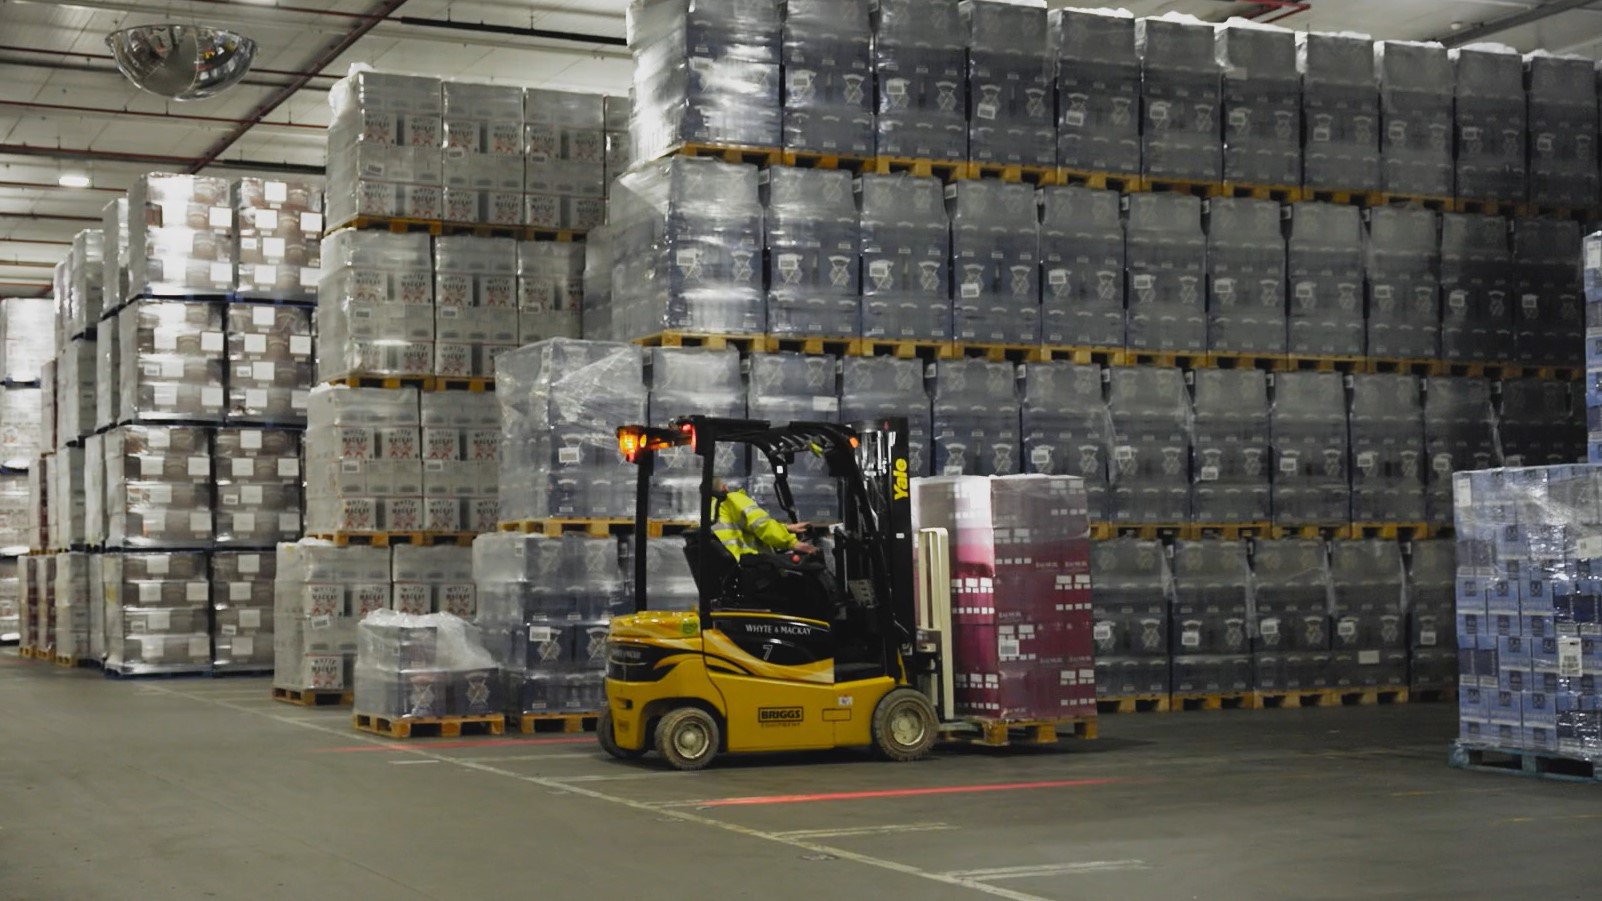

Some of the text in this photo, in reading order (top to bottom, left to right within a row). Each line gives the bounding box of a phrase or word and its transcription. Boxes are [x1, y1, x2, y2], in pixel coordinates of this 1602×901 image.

[745, 624, 772, 633] WHYTE
[780, 626, 811, 635] MACKAY
[763, 645, 773, 660] 7
[761, 710, 800, 719] BRIGGS
